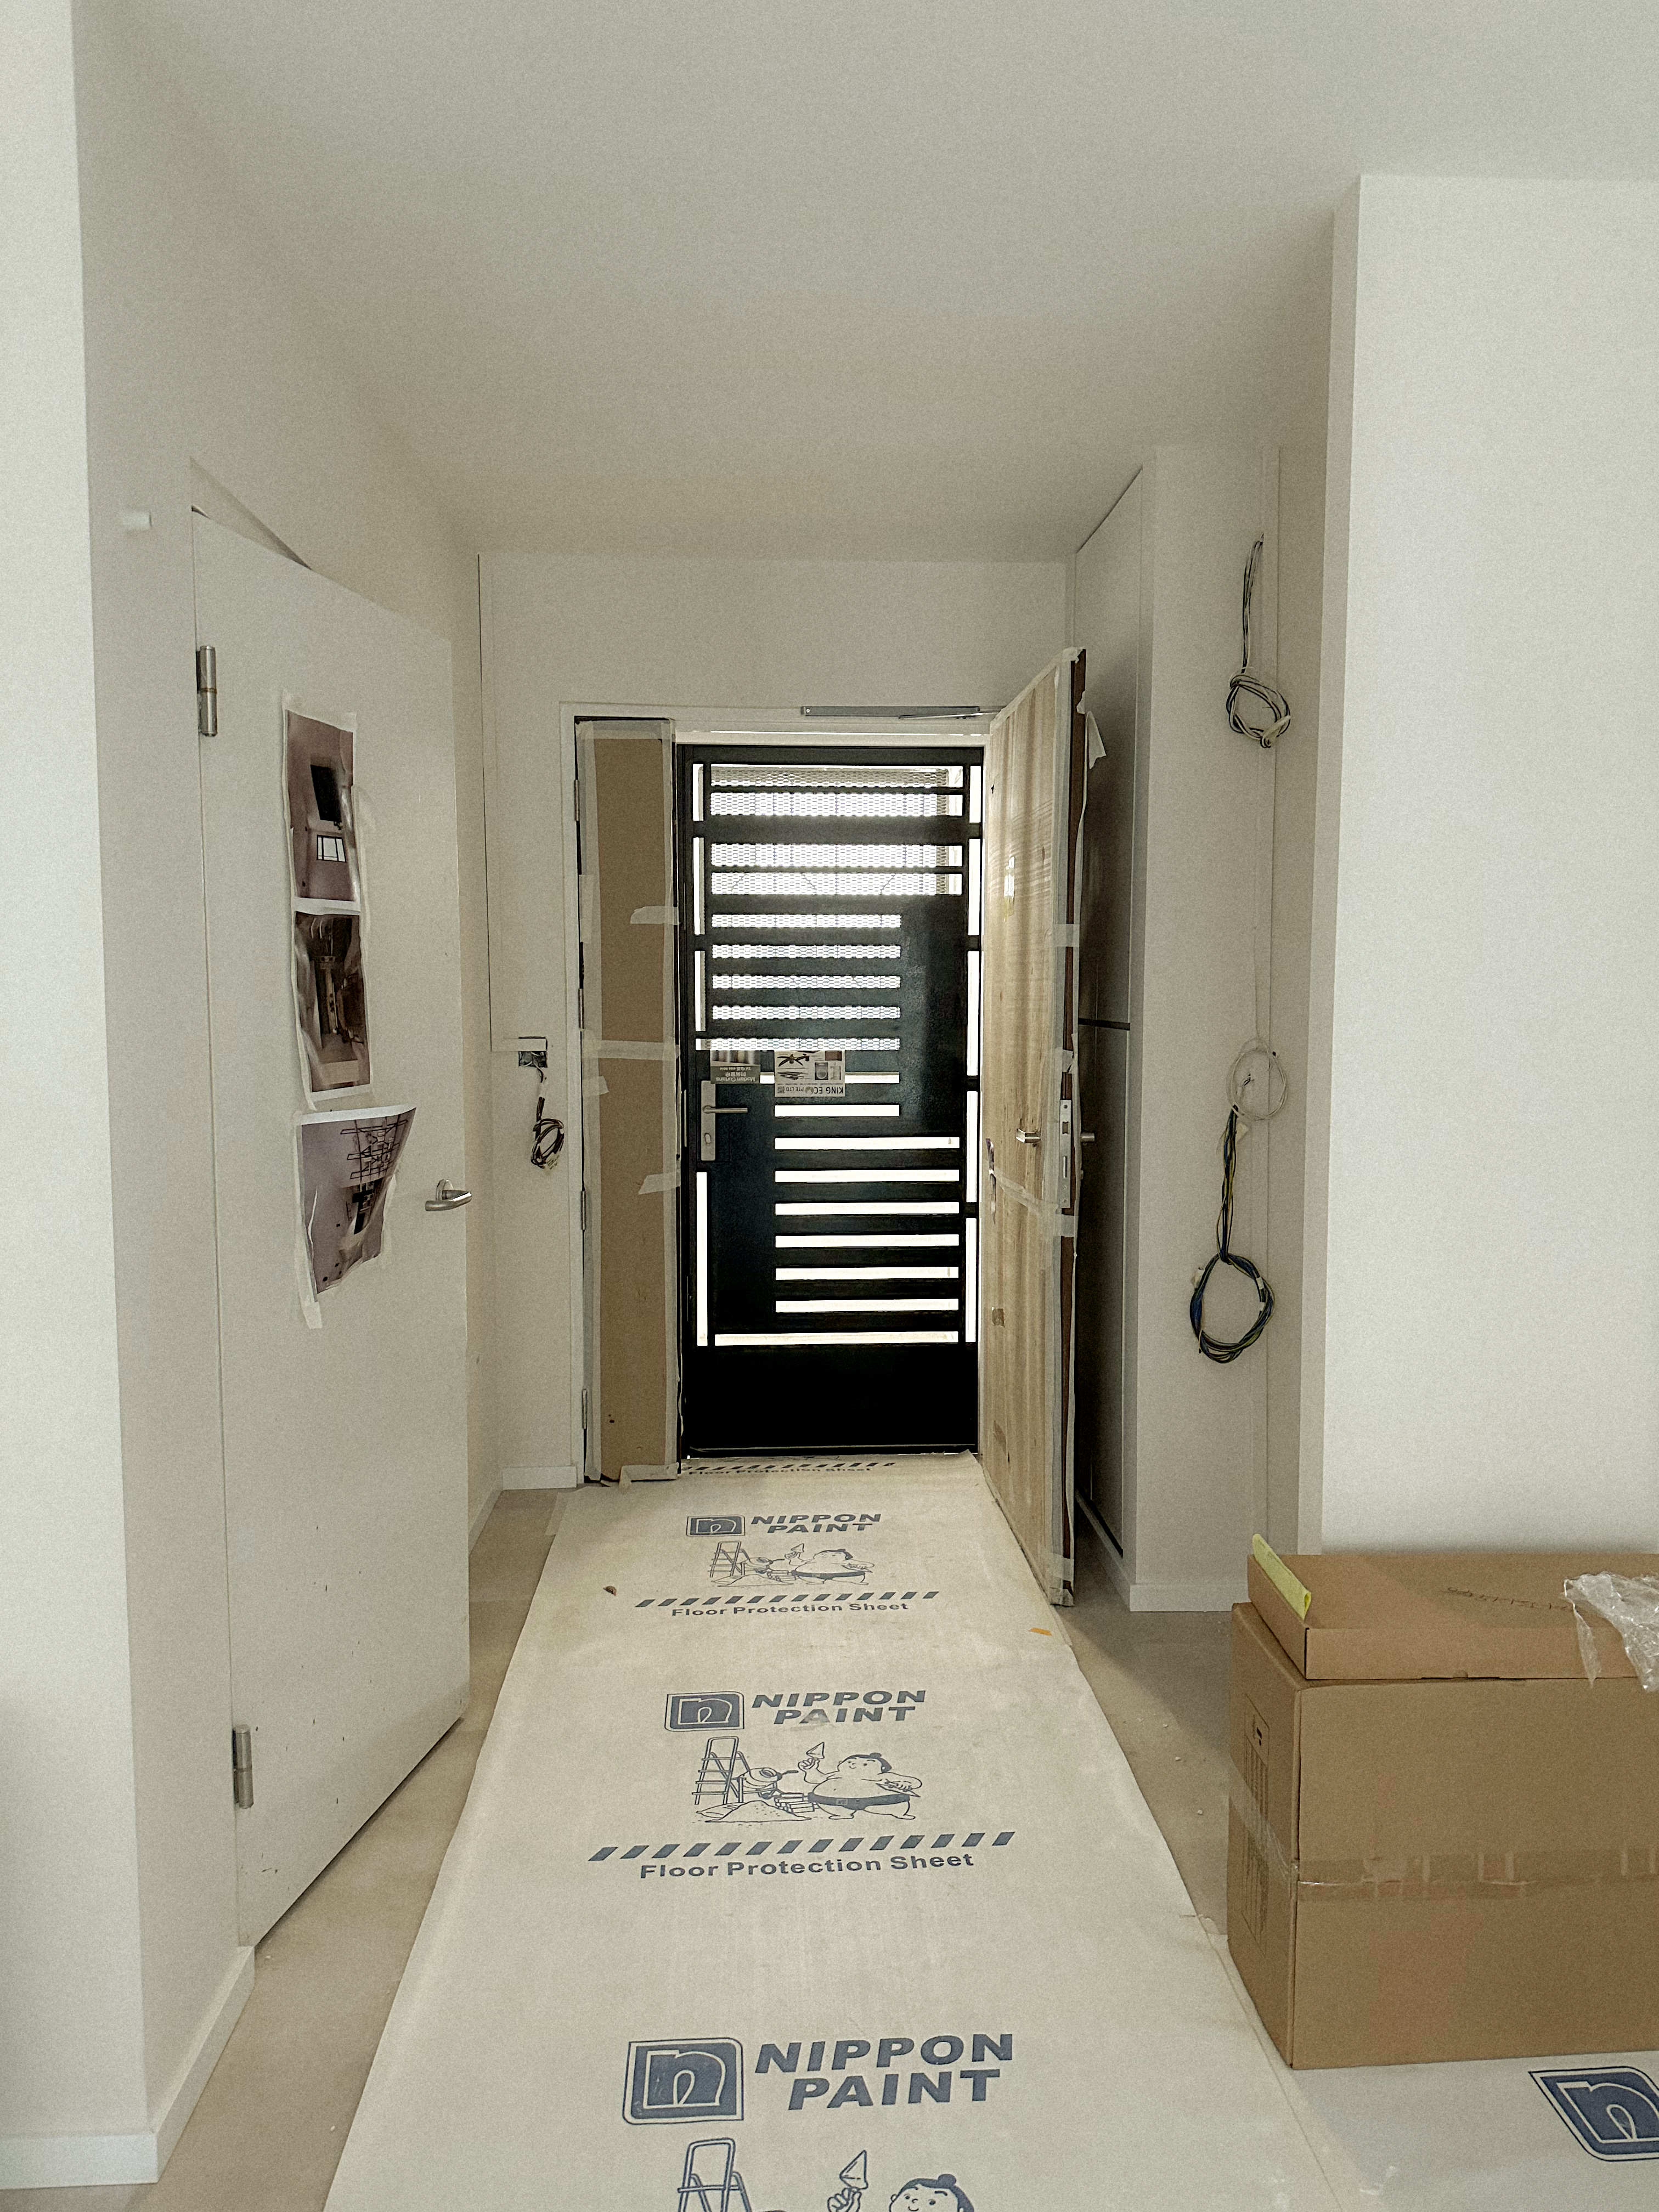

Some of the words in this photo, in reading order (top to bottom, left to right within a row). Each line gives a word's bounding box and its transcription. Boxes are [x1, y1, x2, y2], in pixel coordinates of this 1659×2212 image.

[826, 1086, 844, 1094] KING
[751, 1514, 881, 1525] NIPPON
[767, 1523, 873, 1534] PAINT
[733, 1605, 843, 1615] Protection
[752, 1690, 926, 1708] NIPPON
[773, 1706, 916, 1725] PAINT
[640, 1865, 719, 1879] Floor
[727, 1859, 881, 1876] Protection
[890, 1853, 974, 1870] Sheet
[754, 2033, 1013, 2074] NIPPON
[788, 2069, 1001, 2111] PAINT
